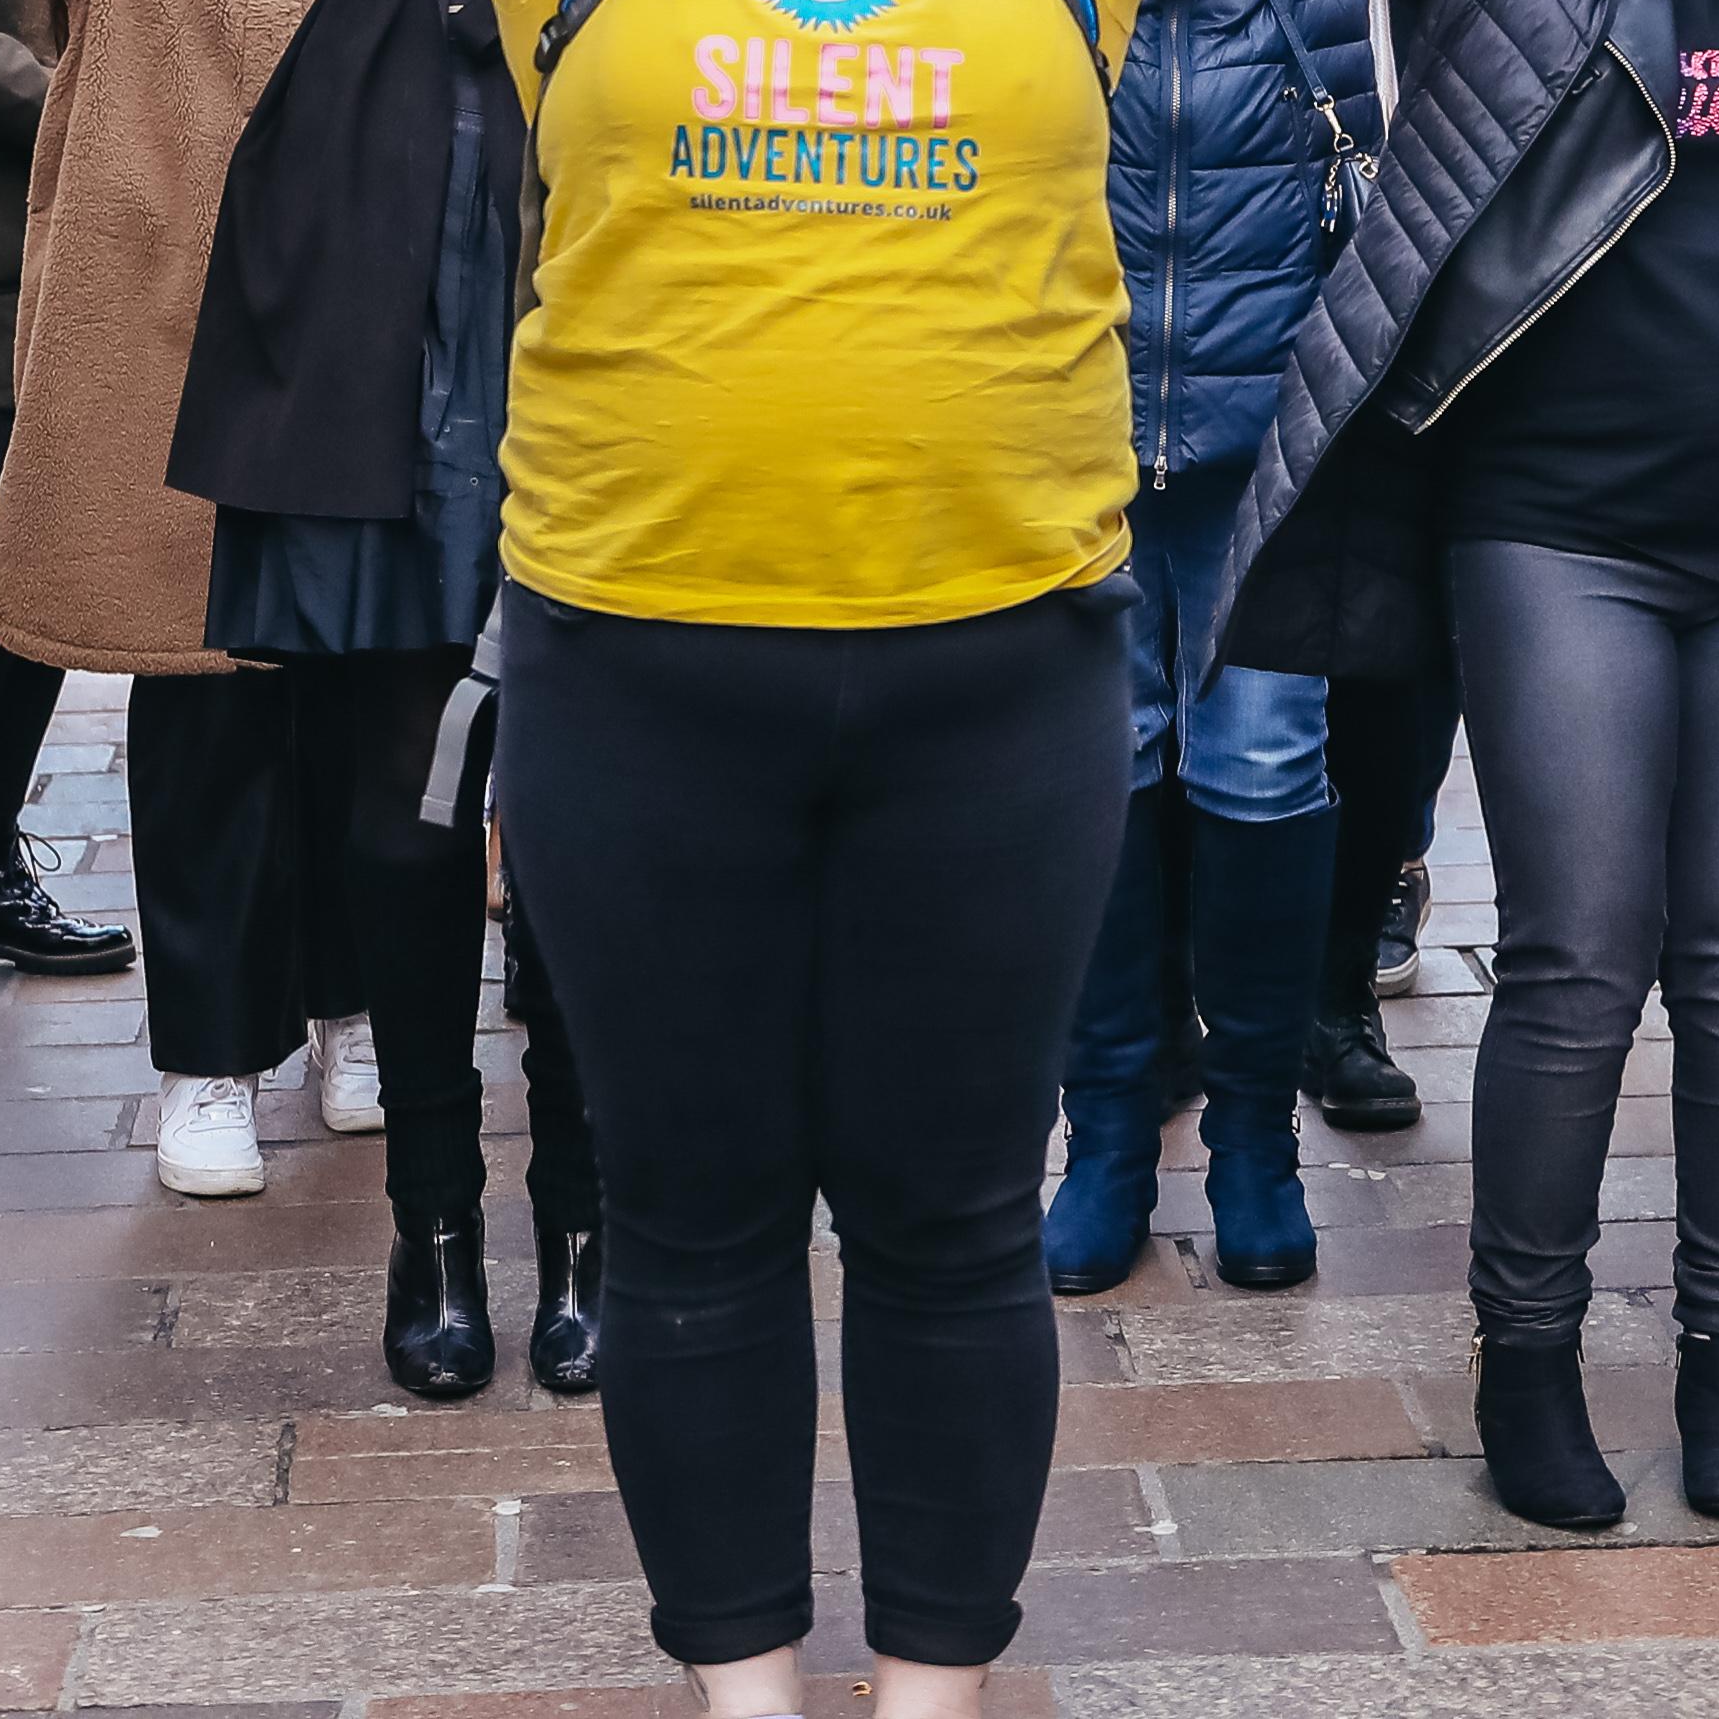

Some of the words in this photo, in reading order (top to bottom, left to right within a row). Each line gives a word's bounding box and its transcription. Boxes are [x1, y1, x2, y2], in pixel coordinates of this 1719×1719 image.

[691, 33, 967, 131] SILENT
[669, 125, 981, 192] ADVENTURES
[689, 193, 953, 222] silentadventures.co.uk
